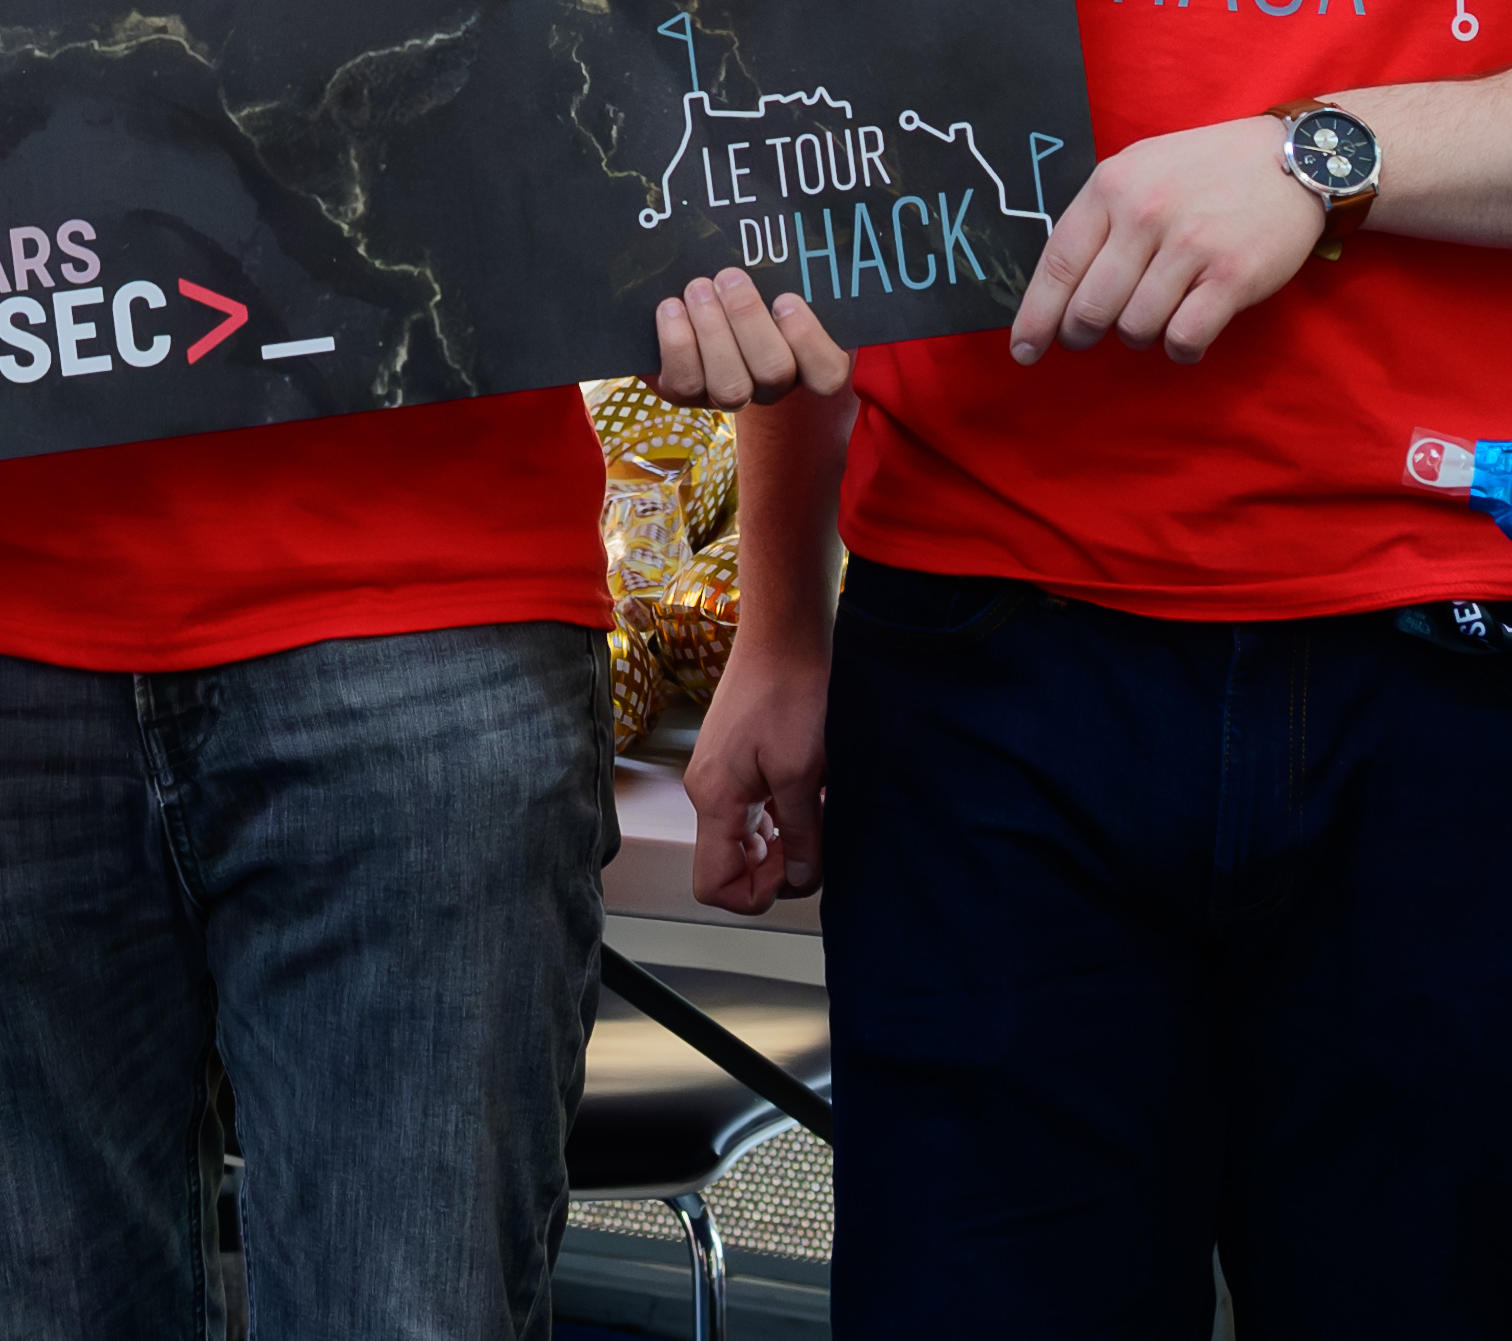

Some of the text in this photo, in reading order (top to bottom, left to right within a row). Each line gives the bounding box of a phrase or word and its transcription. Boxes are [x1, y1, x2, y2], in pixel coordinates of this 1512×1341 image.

[700, 126, 891, 211] LE TOUR
[739, 188, 986, 305] DU HACK
